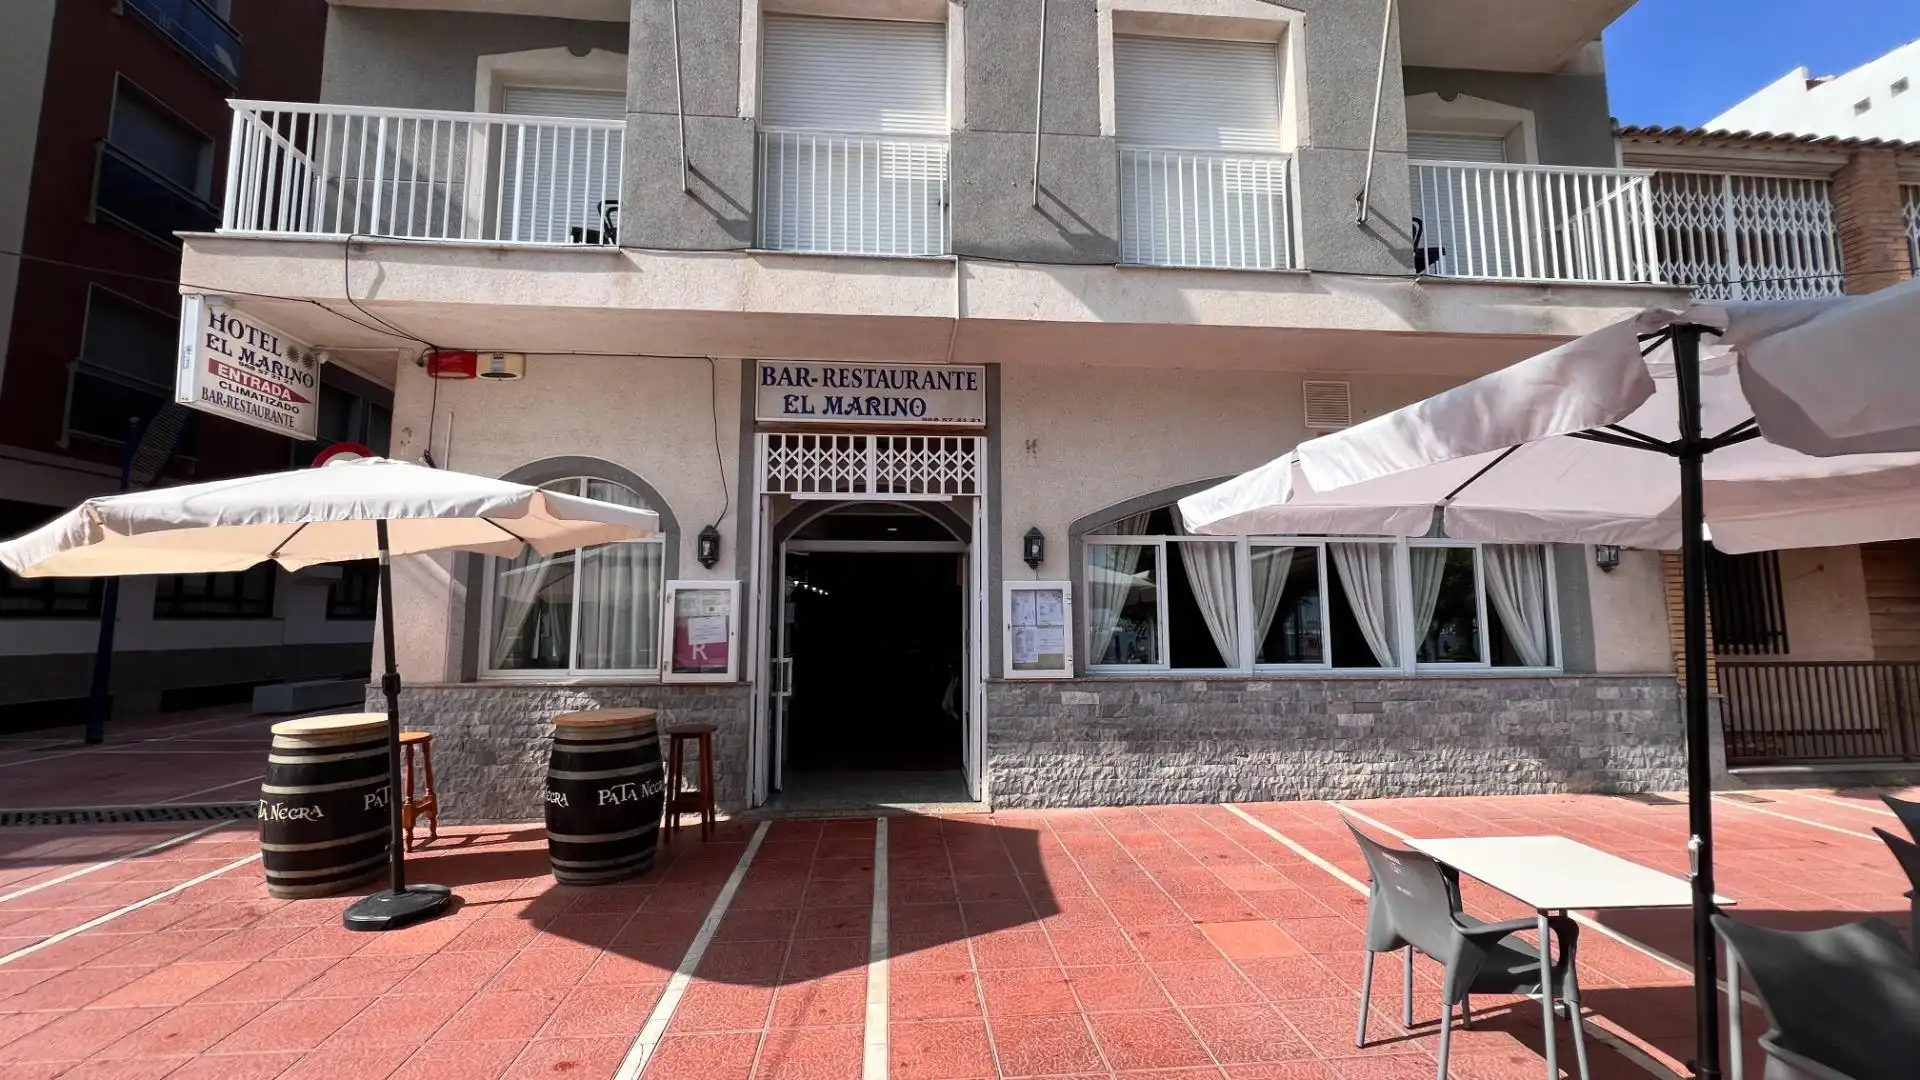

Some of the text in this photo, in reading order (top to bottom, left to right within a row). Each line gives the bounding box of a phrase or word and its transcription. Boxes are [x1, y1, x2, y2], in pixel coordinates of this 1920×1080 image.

[208, 307, 282, 357] HOTEL
[205, 332, 233, 357] EL
[238, 346, 314, 388] MARINO
[217, 364, 292, 401] ENTRADA
[218, 380, 300, 414] CLIMATIZADO
[201, 386, 295, 428] BAR-RESTAURANTE
[783, 394, 927, 418] EL MARINO
[363, 785, 392, 811] PAT
[597, 782, 638, 806] PATA
